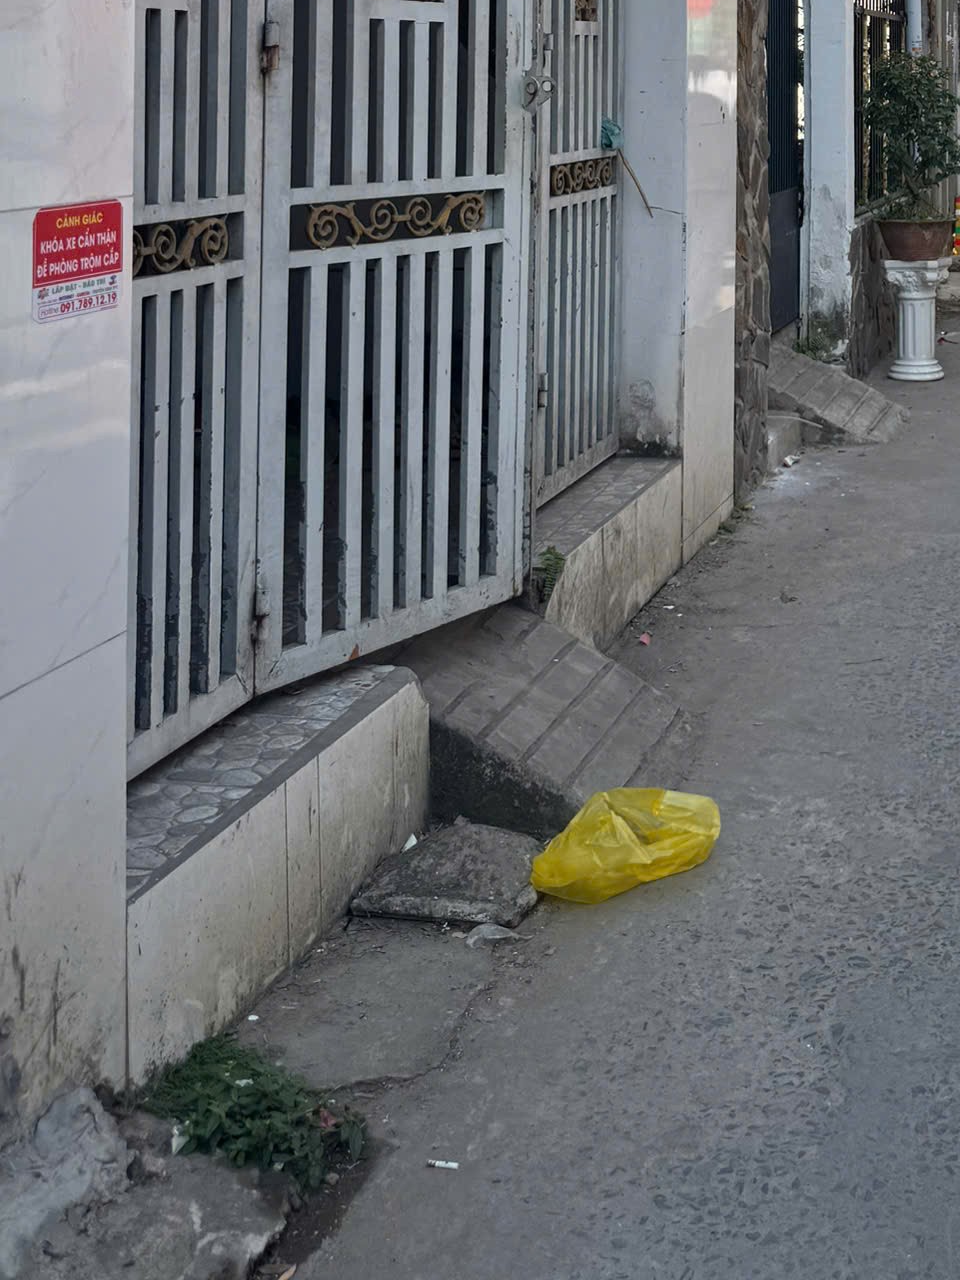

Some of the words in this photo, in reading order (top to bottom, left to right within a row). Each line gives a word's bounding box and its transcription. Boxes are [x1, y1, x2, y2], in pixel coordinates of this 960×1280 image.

[56, 213, 81, 229] CẢNH
[82, 211, 104, 225] GIÁC
[40, 236, 64, 254] KHÓA
[66, 237, 76, 250] XE
[77, 227, 96, 248] CẨN
[96, 228, 117, 247] THẬN
[36, 258, 48, 278] ĐỀ
[49, 258, 79, 276] PHÒNG
[80, 252, 102, 272] TRỘM
[60, 291, 117, 313] 091.789.12.19
